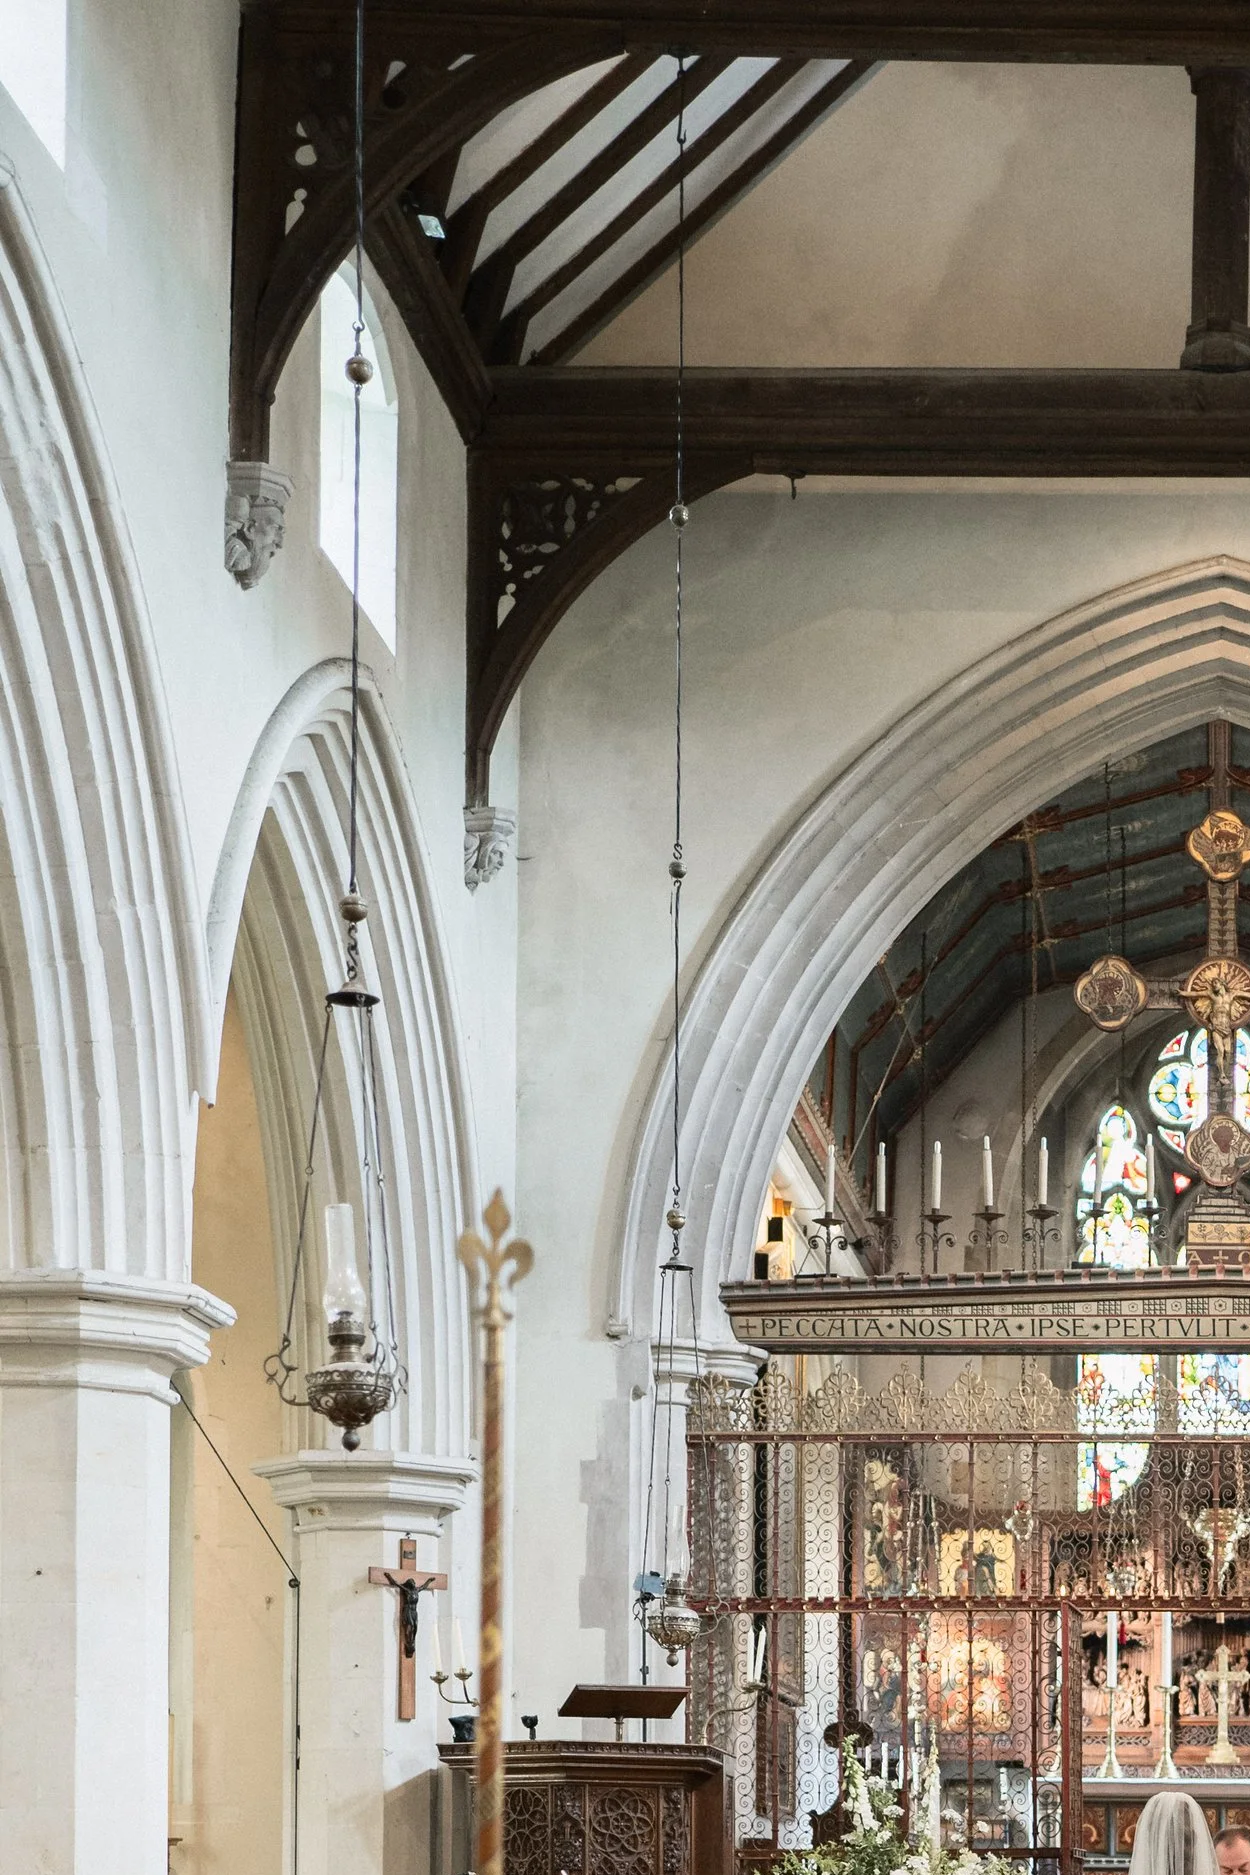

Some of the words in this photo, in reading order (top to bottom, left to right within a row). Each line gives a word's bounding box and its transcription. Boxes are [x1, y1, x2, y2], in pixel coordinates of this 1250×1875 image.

[1187, 1250, 1203, 1266] A
[761, 1318, 885, 1337] PECCATA
[900, 1318, 1012, 1337] NOSTRA
[1030, 1318, 1089, 1337] IPSE
[1105, 1318, 1237, 1337] PERTVLIT
